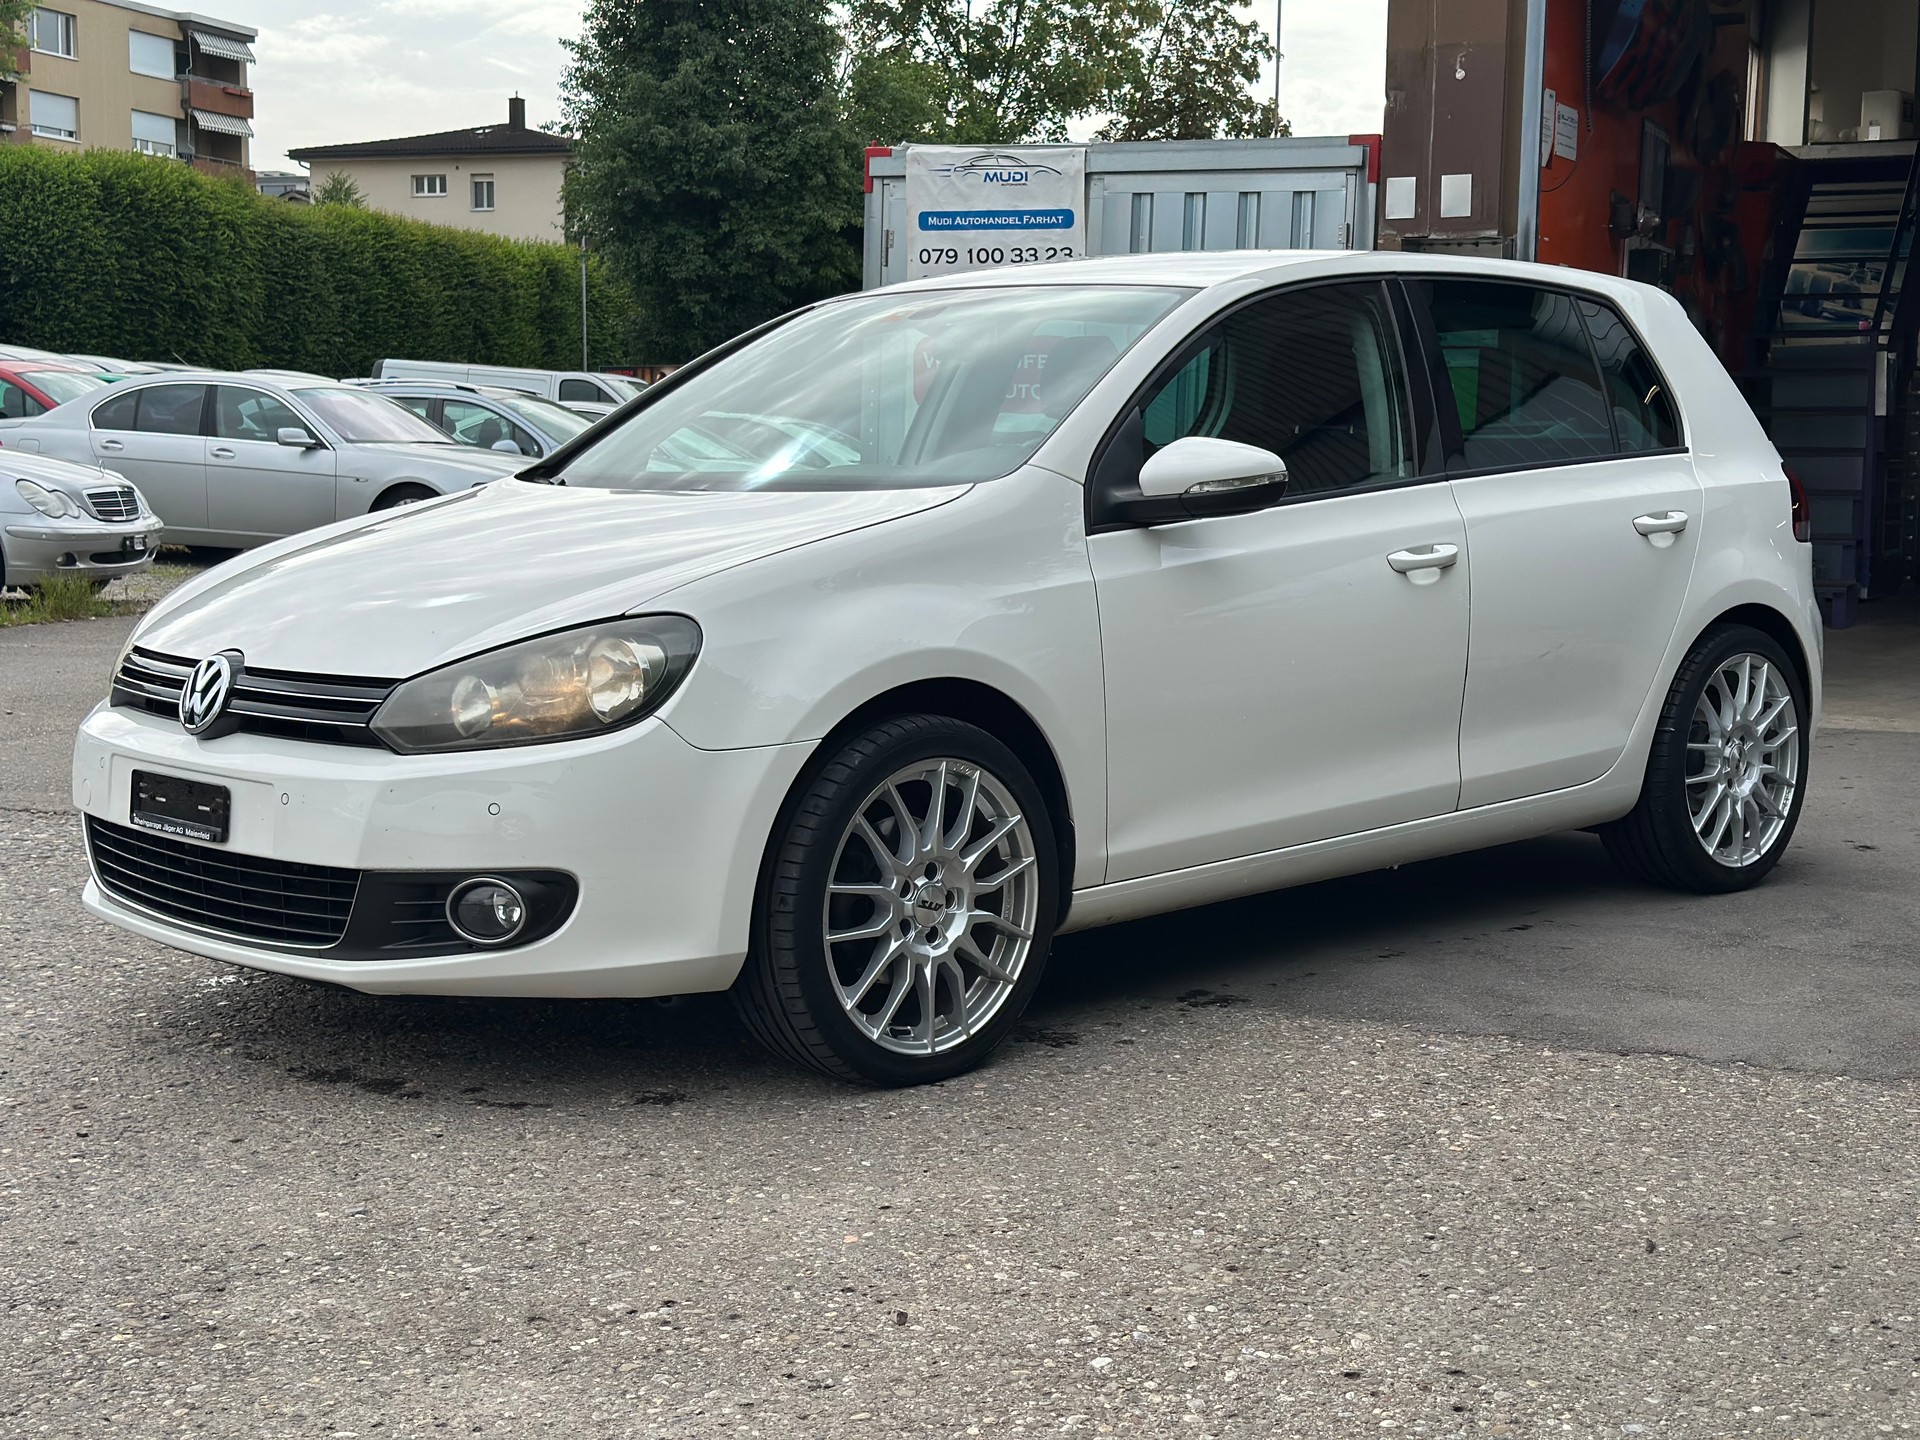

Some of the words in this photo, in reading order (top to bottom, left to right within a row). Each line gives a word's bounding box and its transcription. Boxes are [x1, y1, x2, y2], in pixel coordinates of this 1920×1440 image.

[984, 171, 1028, 182] MUDI
[919, 248, 958, 264] 079
[967, 247, 1004, 264] 100
[1010, 247, 1039, 264] 33
[176, 826, 183, 834] AG
[185, 828, 210, 840] Maienfeld
